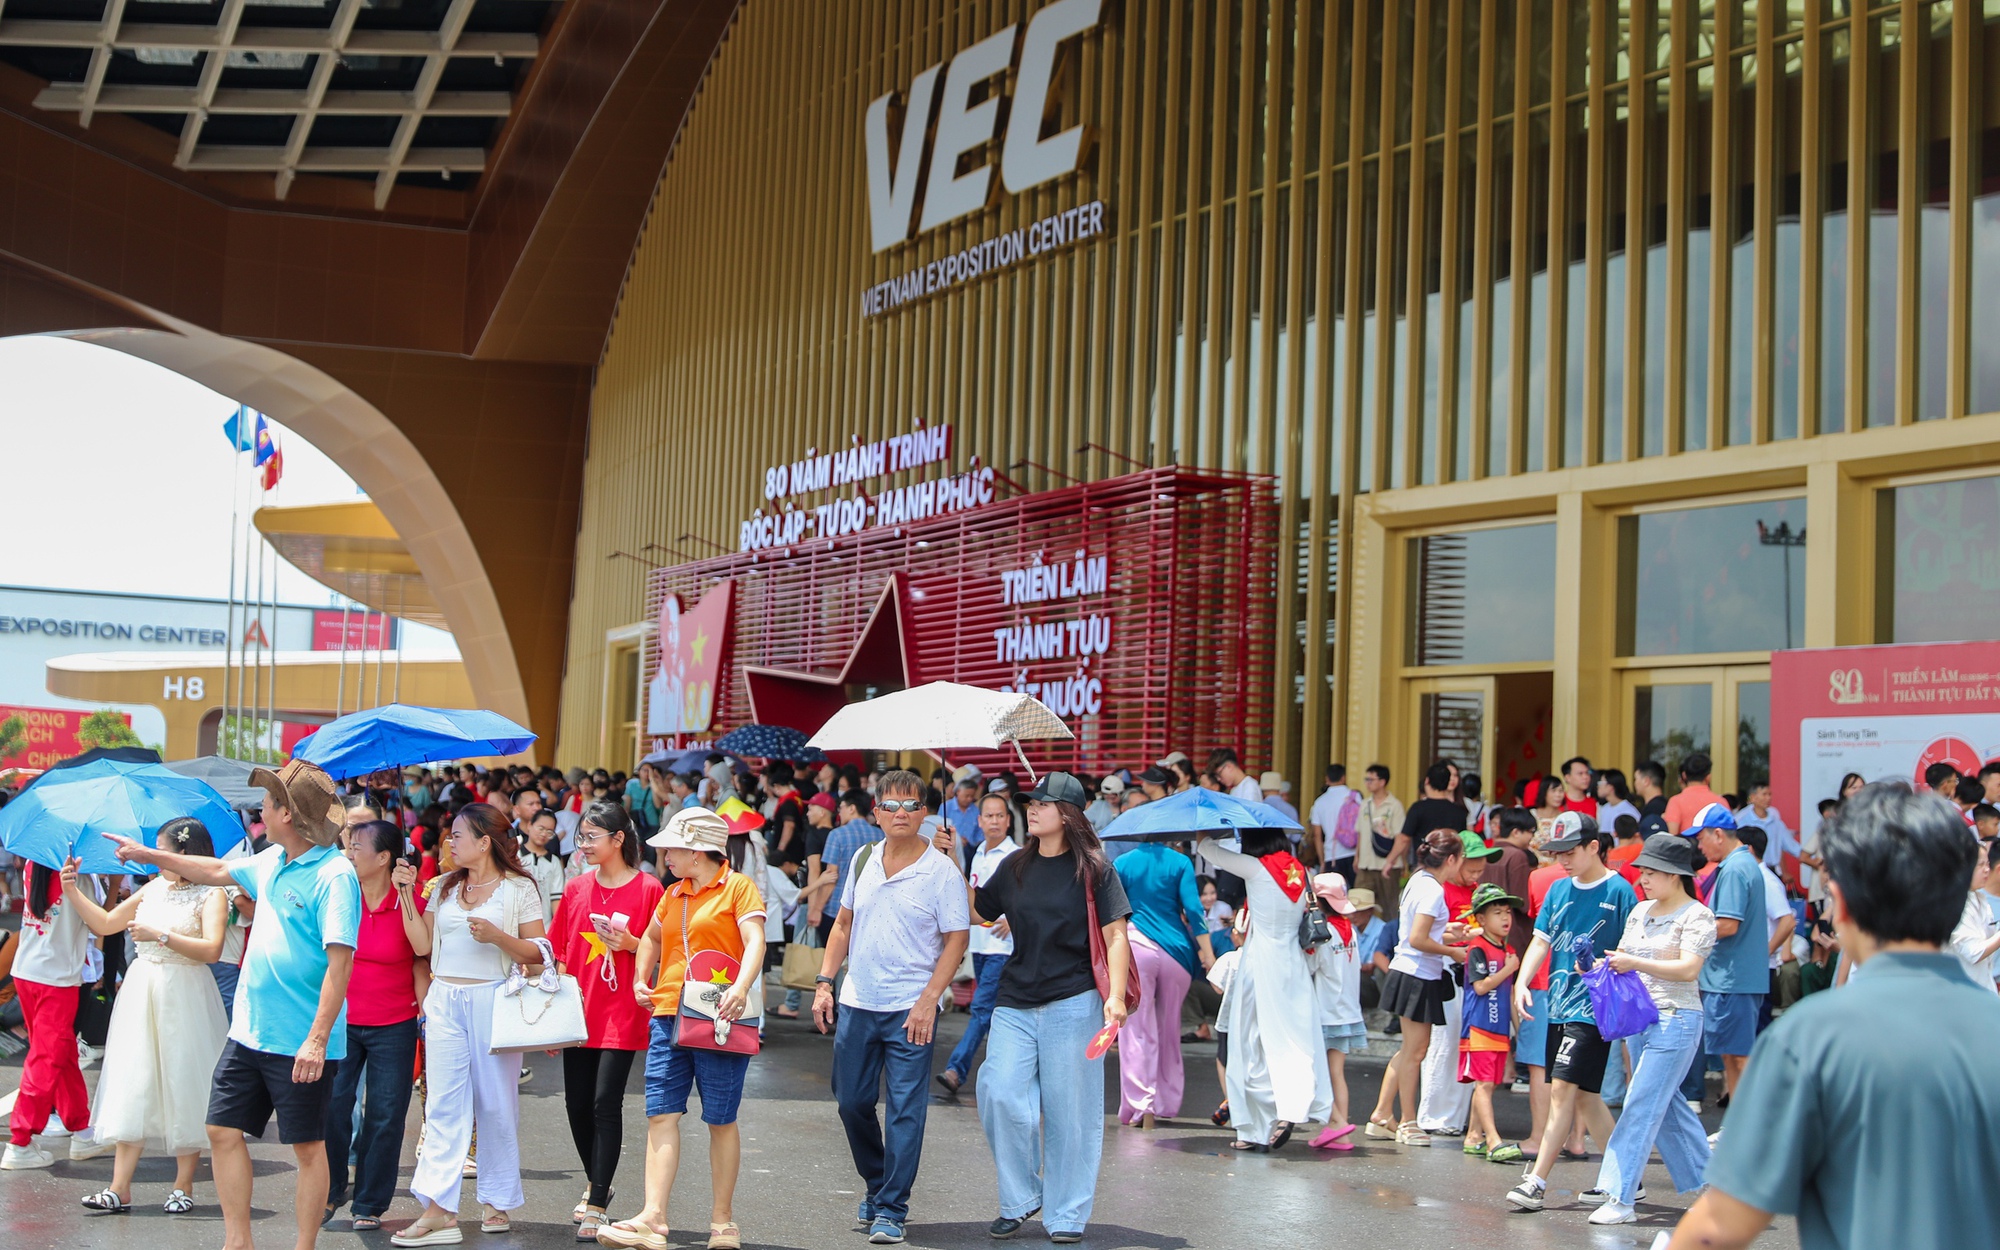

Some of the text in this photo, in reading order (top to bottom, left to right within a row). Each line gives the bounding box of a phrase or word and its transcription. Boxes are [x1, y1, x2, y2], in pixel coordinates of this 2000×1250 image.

[865, 0, 1101, 254] VEC
[861, 199, 1104, 319] VIETNAM EXPOSITION CENTER
[765, 416, 948, 500] 80 NĂM HÀNH TRÌNH
[740, 507, 774, 563] ĐỘC
[774, 501, 806, 558] LẬP
[816, 497, 842, 551] TỰ
[839, 496, 867, 536] DO
[877, 479, 936, 538] HẠNH
[936, 455, 995, 515] PHÚC
[1001, 548, 1108, 606] TRIỂN LÃM
[0, 616, 226, 646] EXPOSITION CENTER
[994, 613, 1111, 667] THÀNH TỰU
[163, 675, 205, 701] H8
[684, 680, 711, 730] 80
[1041, 667, 1103, 718] NƯỚC
[1828, 668, 1863, 705] 80
[1488, 1002, 1499, 1024] 2022
